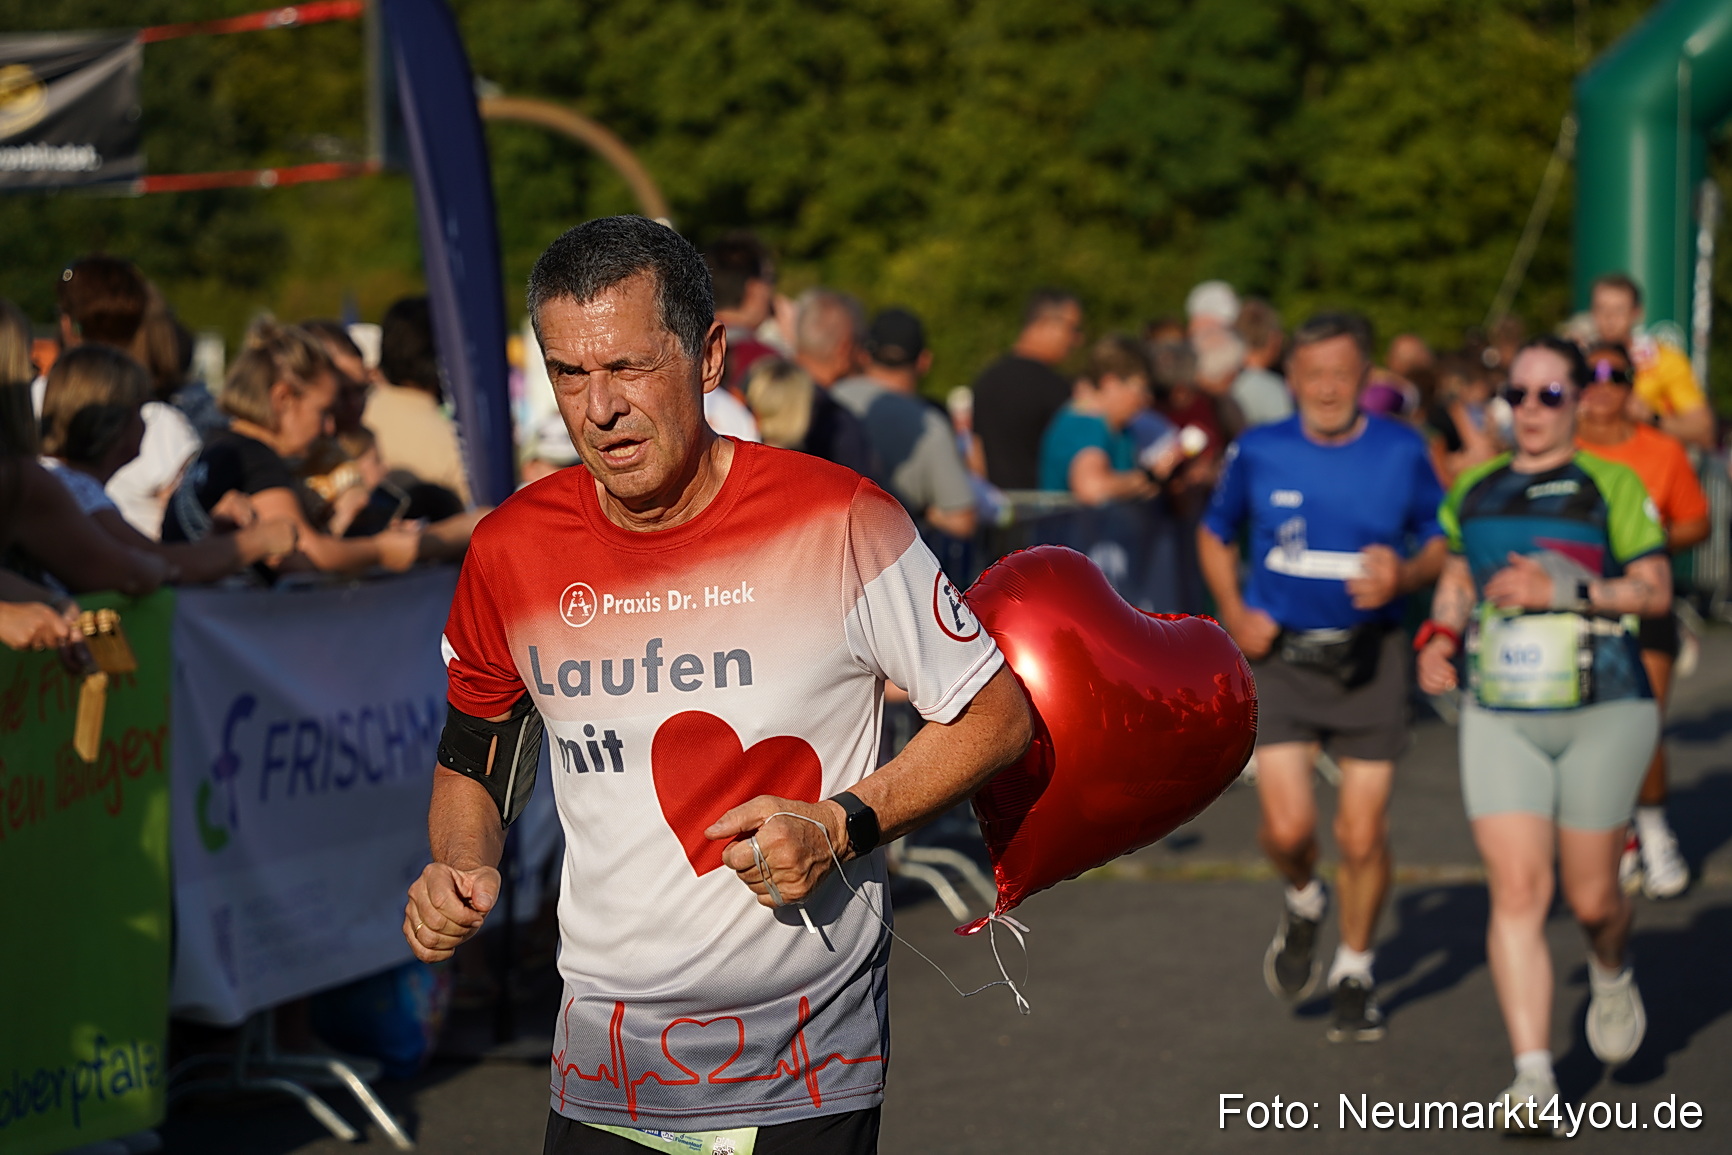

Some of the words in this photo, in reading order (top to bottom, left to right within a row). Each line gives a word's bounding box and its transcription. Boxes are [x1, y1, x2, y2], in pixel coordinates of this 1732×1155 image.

[603, 591, 661, 614] Praxis
[667, 590, 697, 611] Dr.
[704, 581, 755, 607] Heck
[528, 637, 753, 697] Laufen
